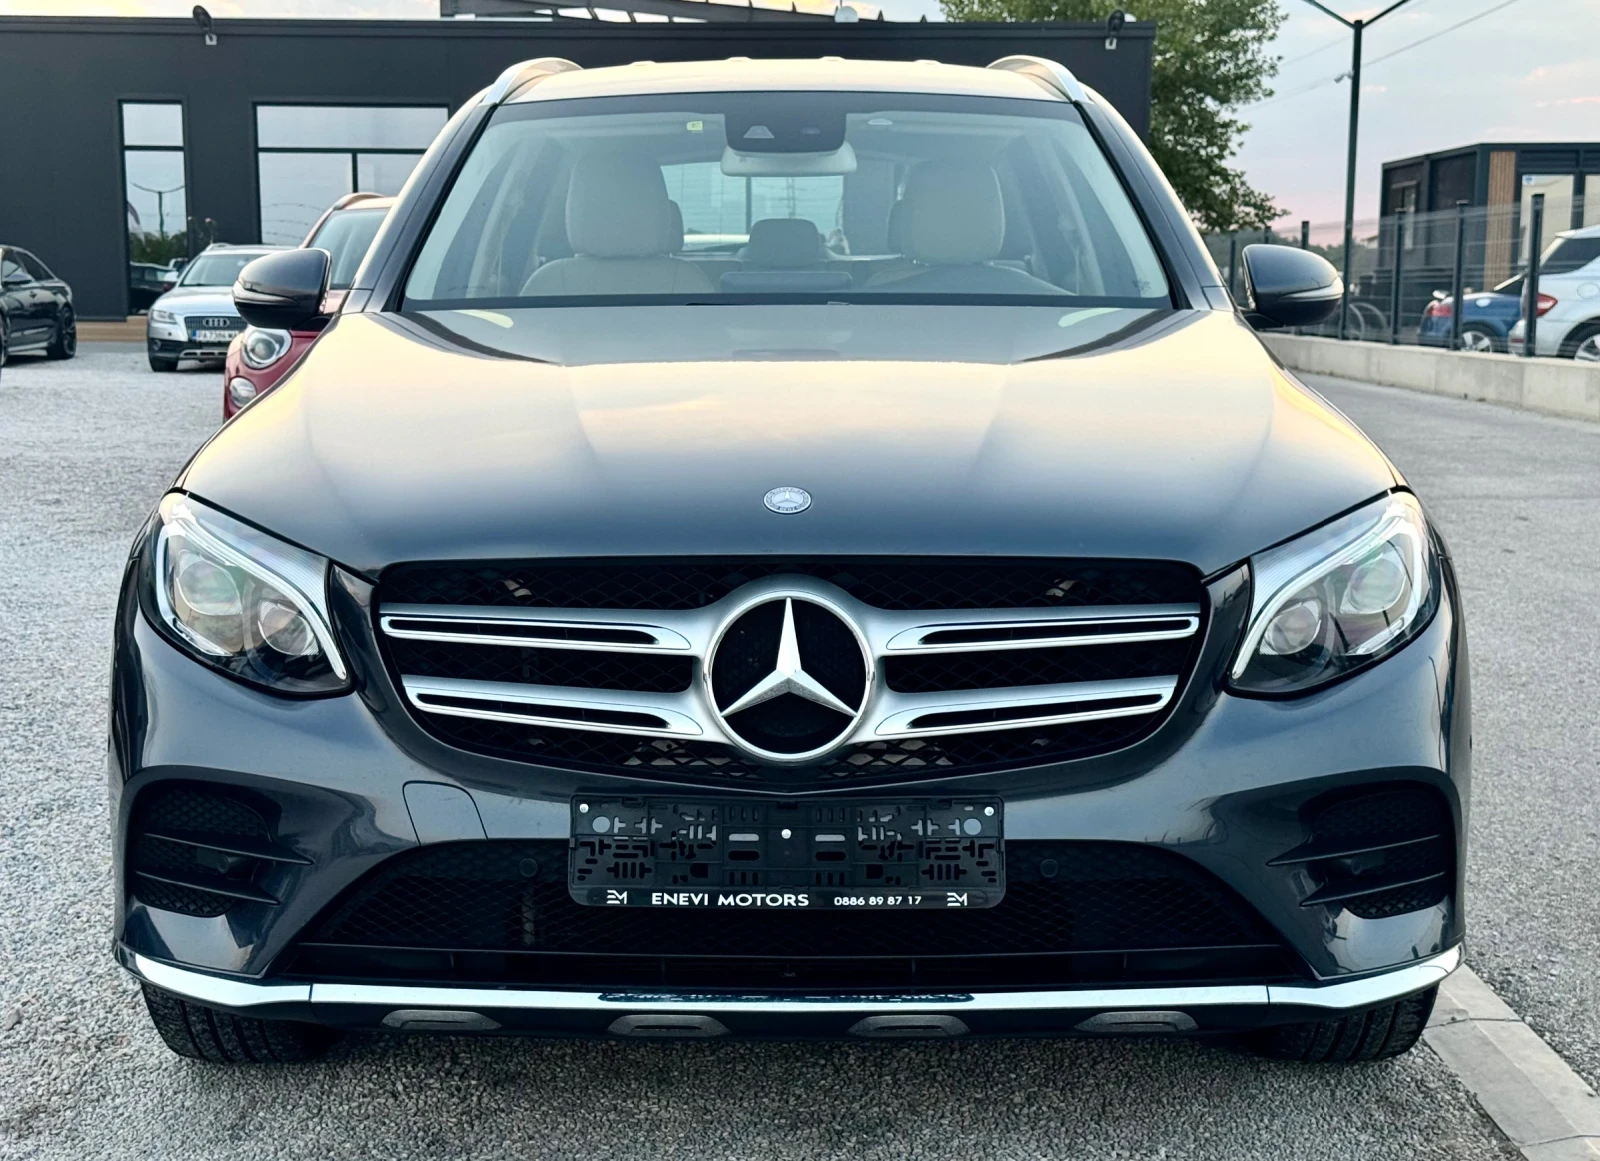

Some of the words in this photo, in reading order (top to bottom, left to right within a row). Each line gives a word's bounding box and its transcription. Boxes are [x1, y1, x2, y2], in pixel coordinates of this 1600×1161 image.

[651, 892, 709, 906] ENEVI
[717, 893, 810, 907] MOTORS
[833, 896, 866, 906] 0886
[868, 896, 885, 906] 89
[887, 896, 903, 906] 87
[907, 895, 922, 905] 17
